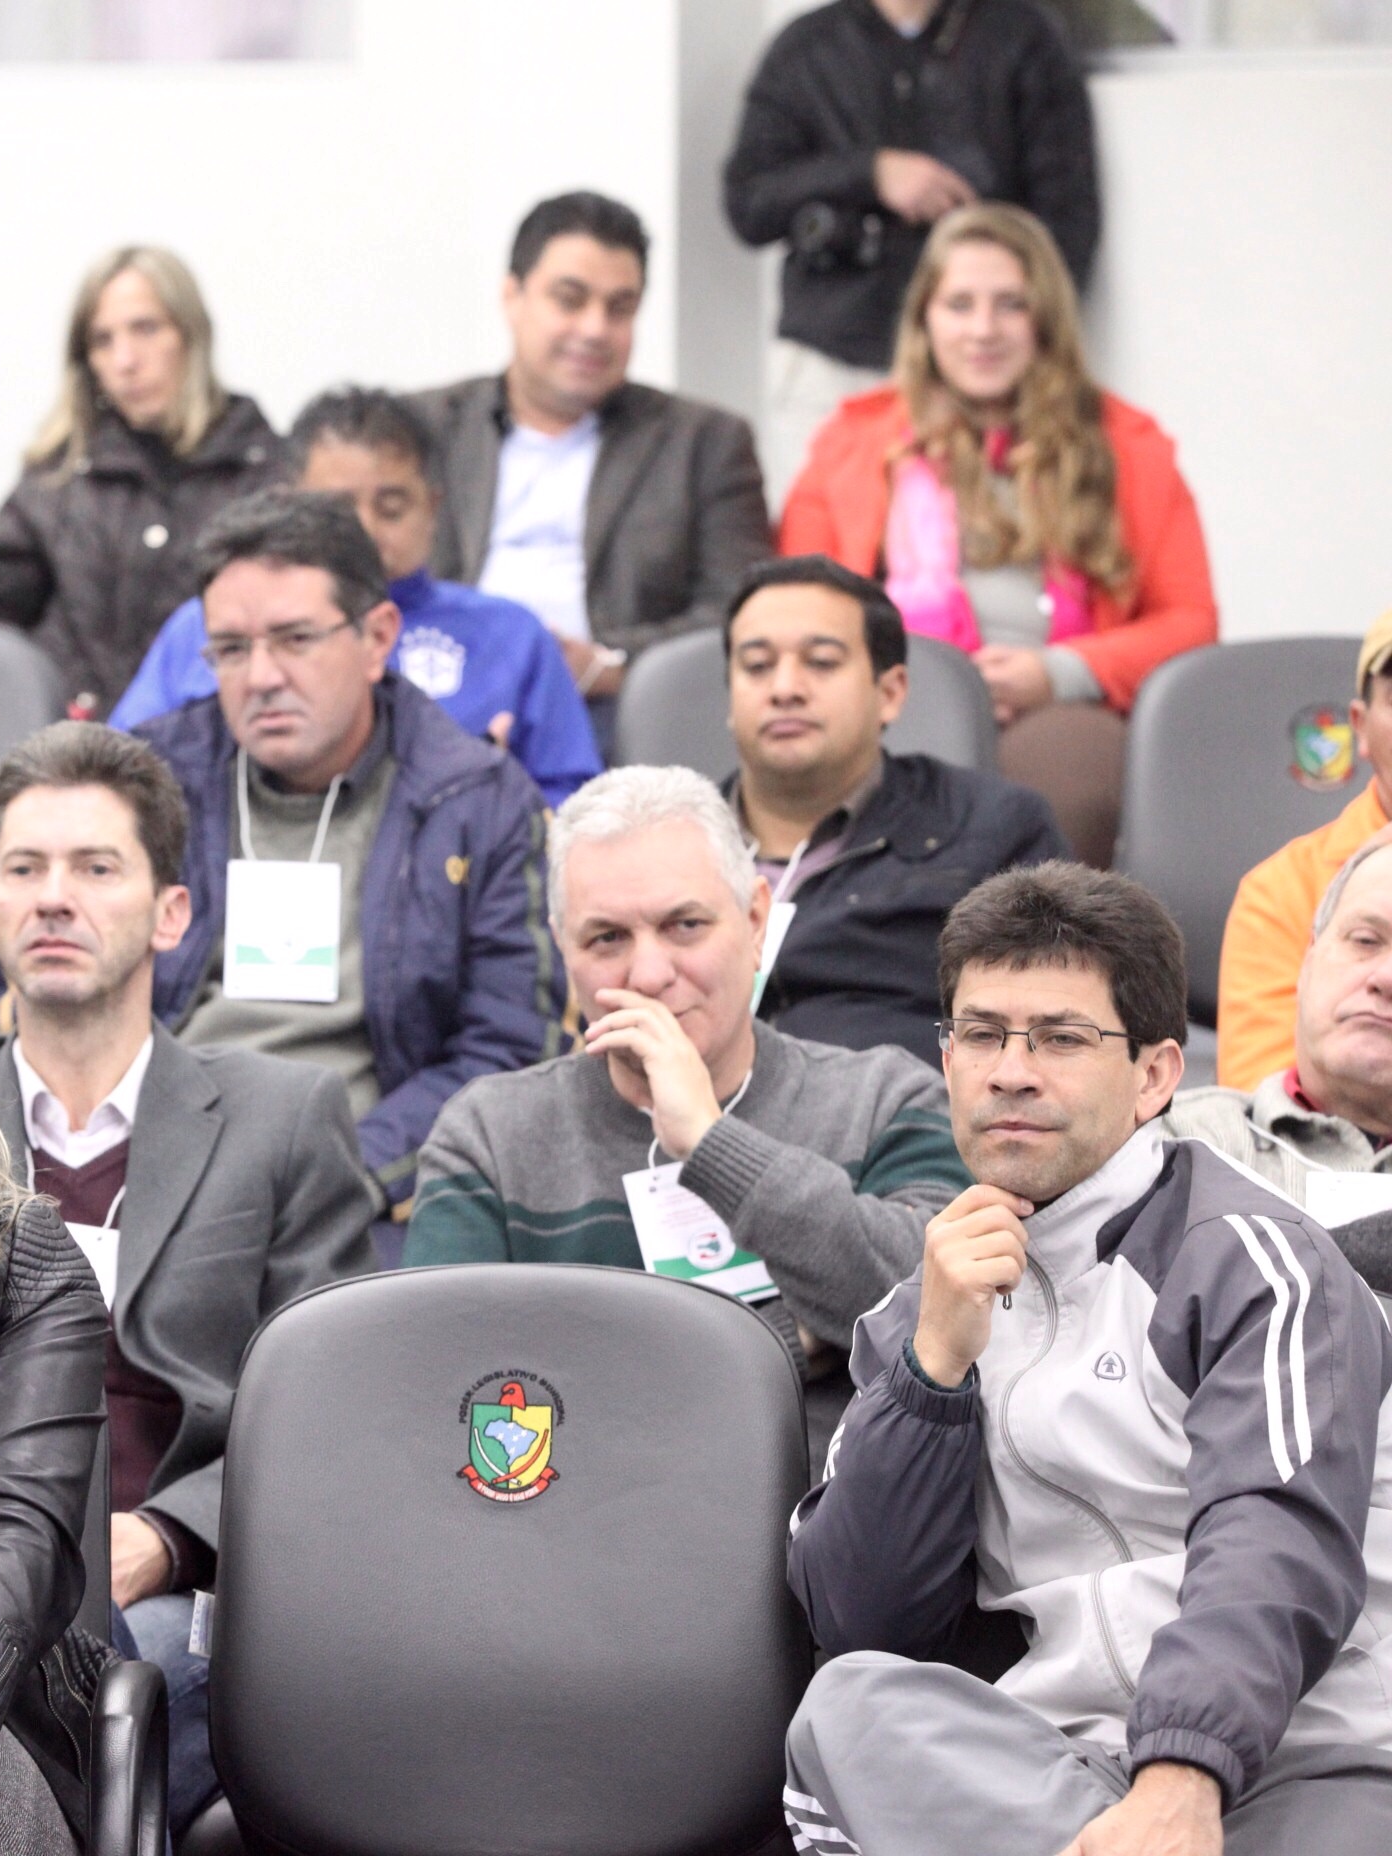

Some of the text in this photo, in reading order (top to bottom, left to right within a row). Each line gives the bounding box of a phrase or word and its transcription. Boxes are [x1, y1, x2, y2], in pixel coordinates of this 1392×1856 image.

[459, 1369, 565, 1426] PODER LEGISLATIVO MUNICIPAL
